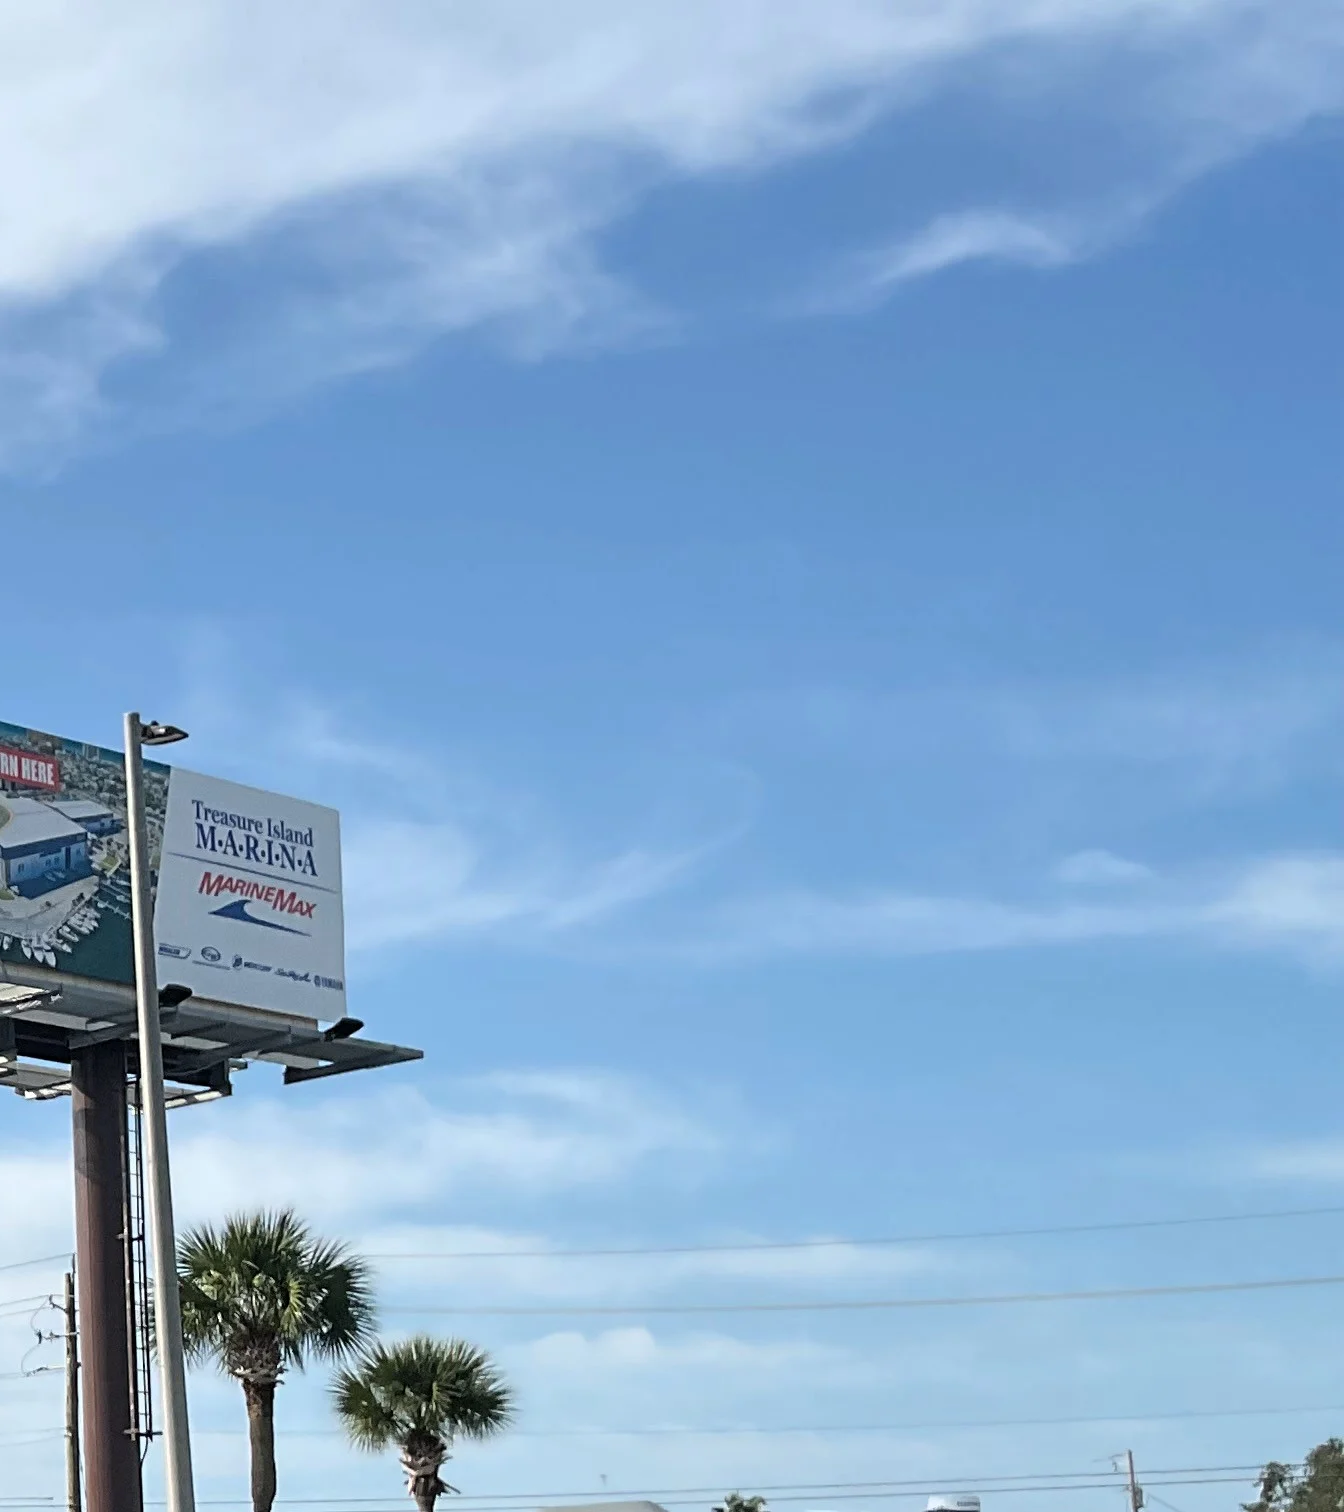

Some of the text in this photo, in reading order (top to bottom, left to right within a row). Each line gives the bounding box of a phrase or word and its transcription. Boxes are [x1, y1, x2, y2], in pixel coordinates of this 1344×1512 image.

[21, 757, 55, 785] HERE
[192, 799, 314, 847] Treasure Island
